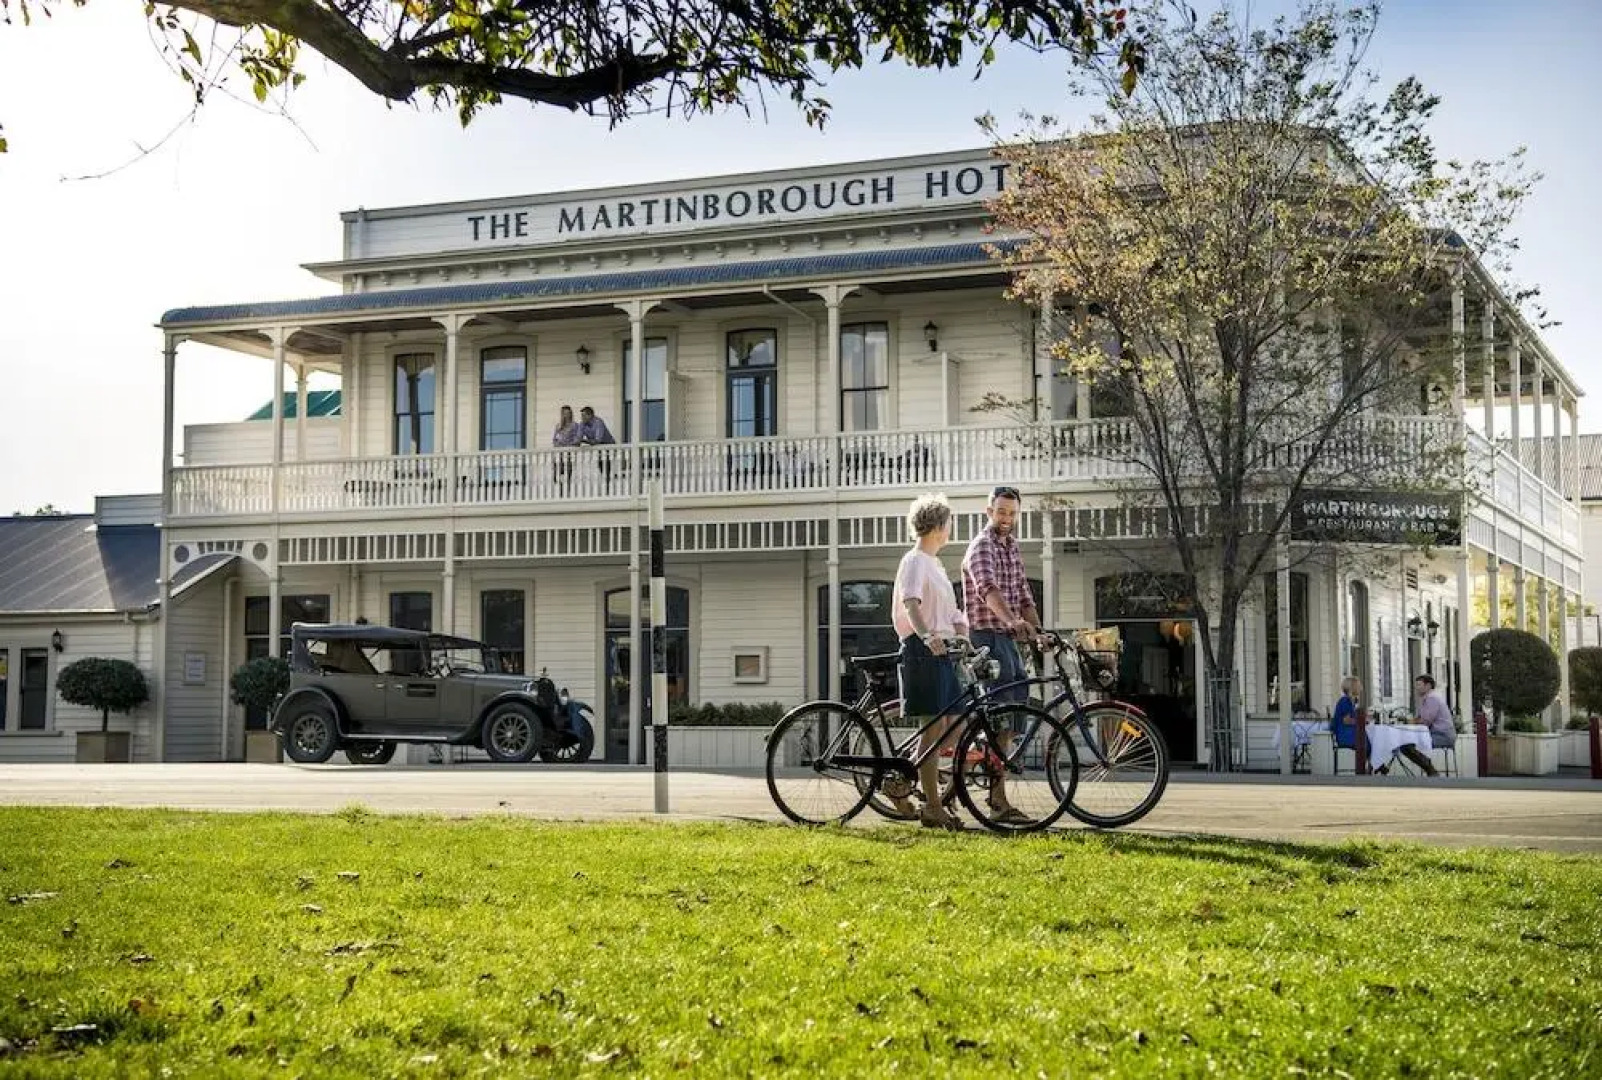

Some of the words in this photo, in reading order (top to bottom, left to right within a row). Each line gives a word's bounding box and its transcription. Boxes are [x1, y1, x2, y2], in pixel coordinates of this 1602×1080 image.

[467, 212, 528, 241] THE
[558, 175, 895, 234] MARTINBOROUGH
[925, 163, 1025, 199] HOT
